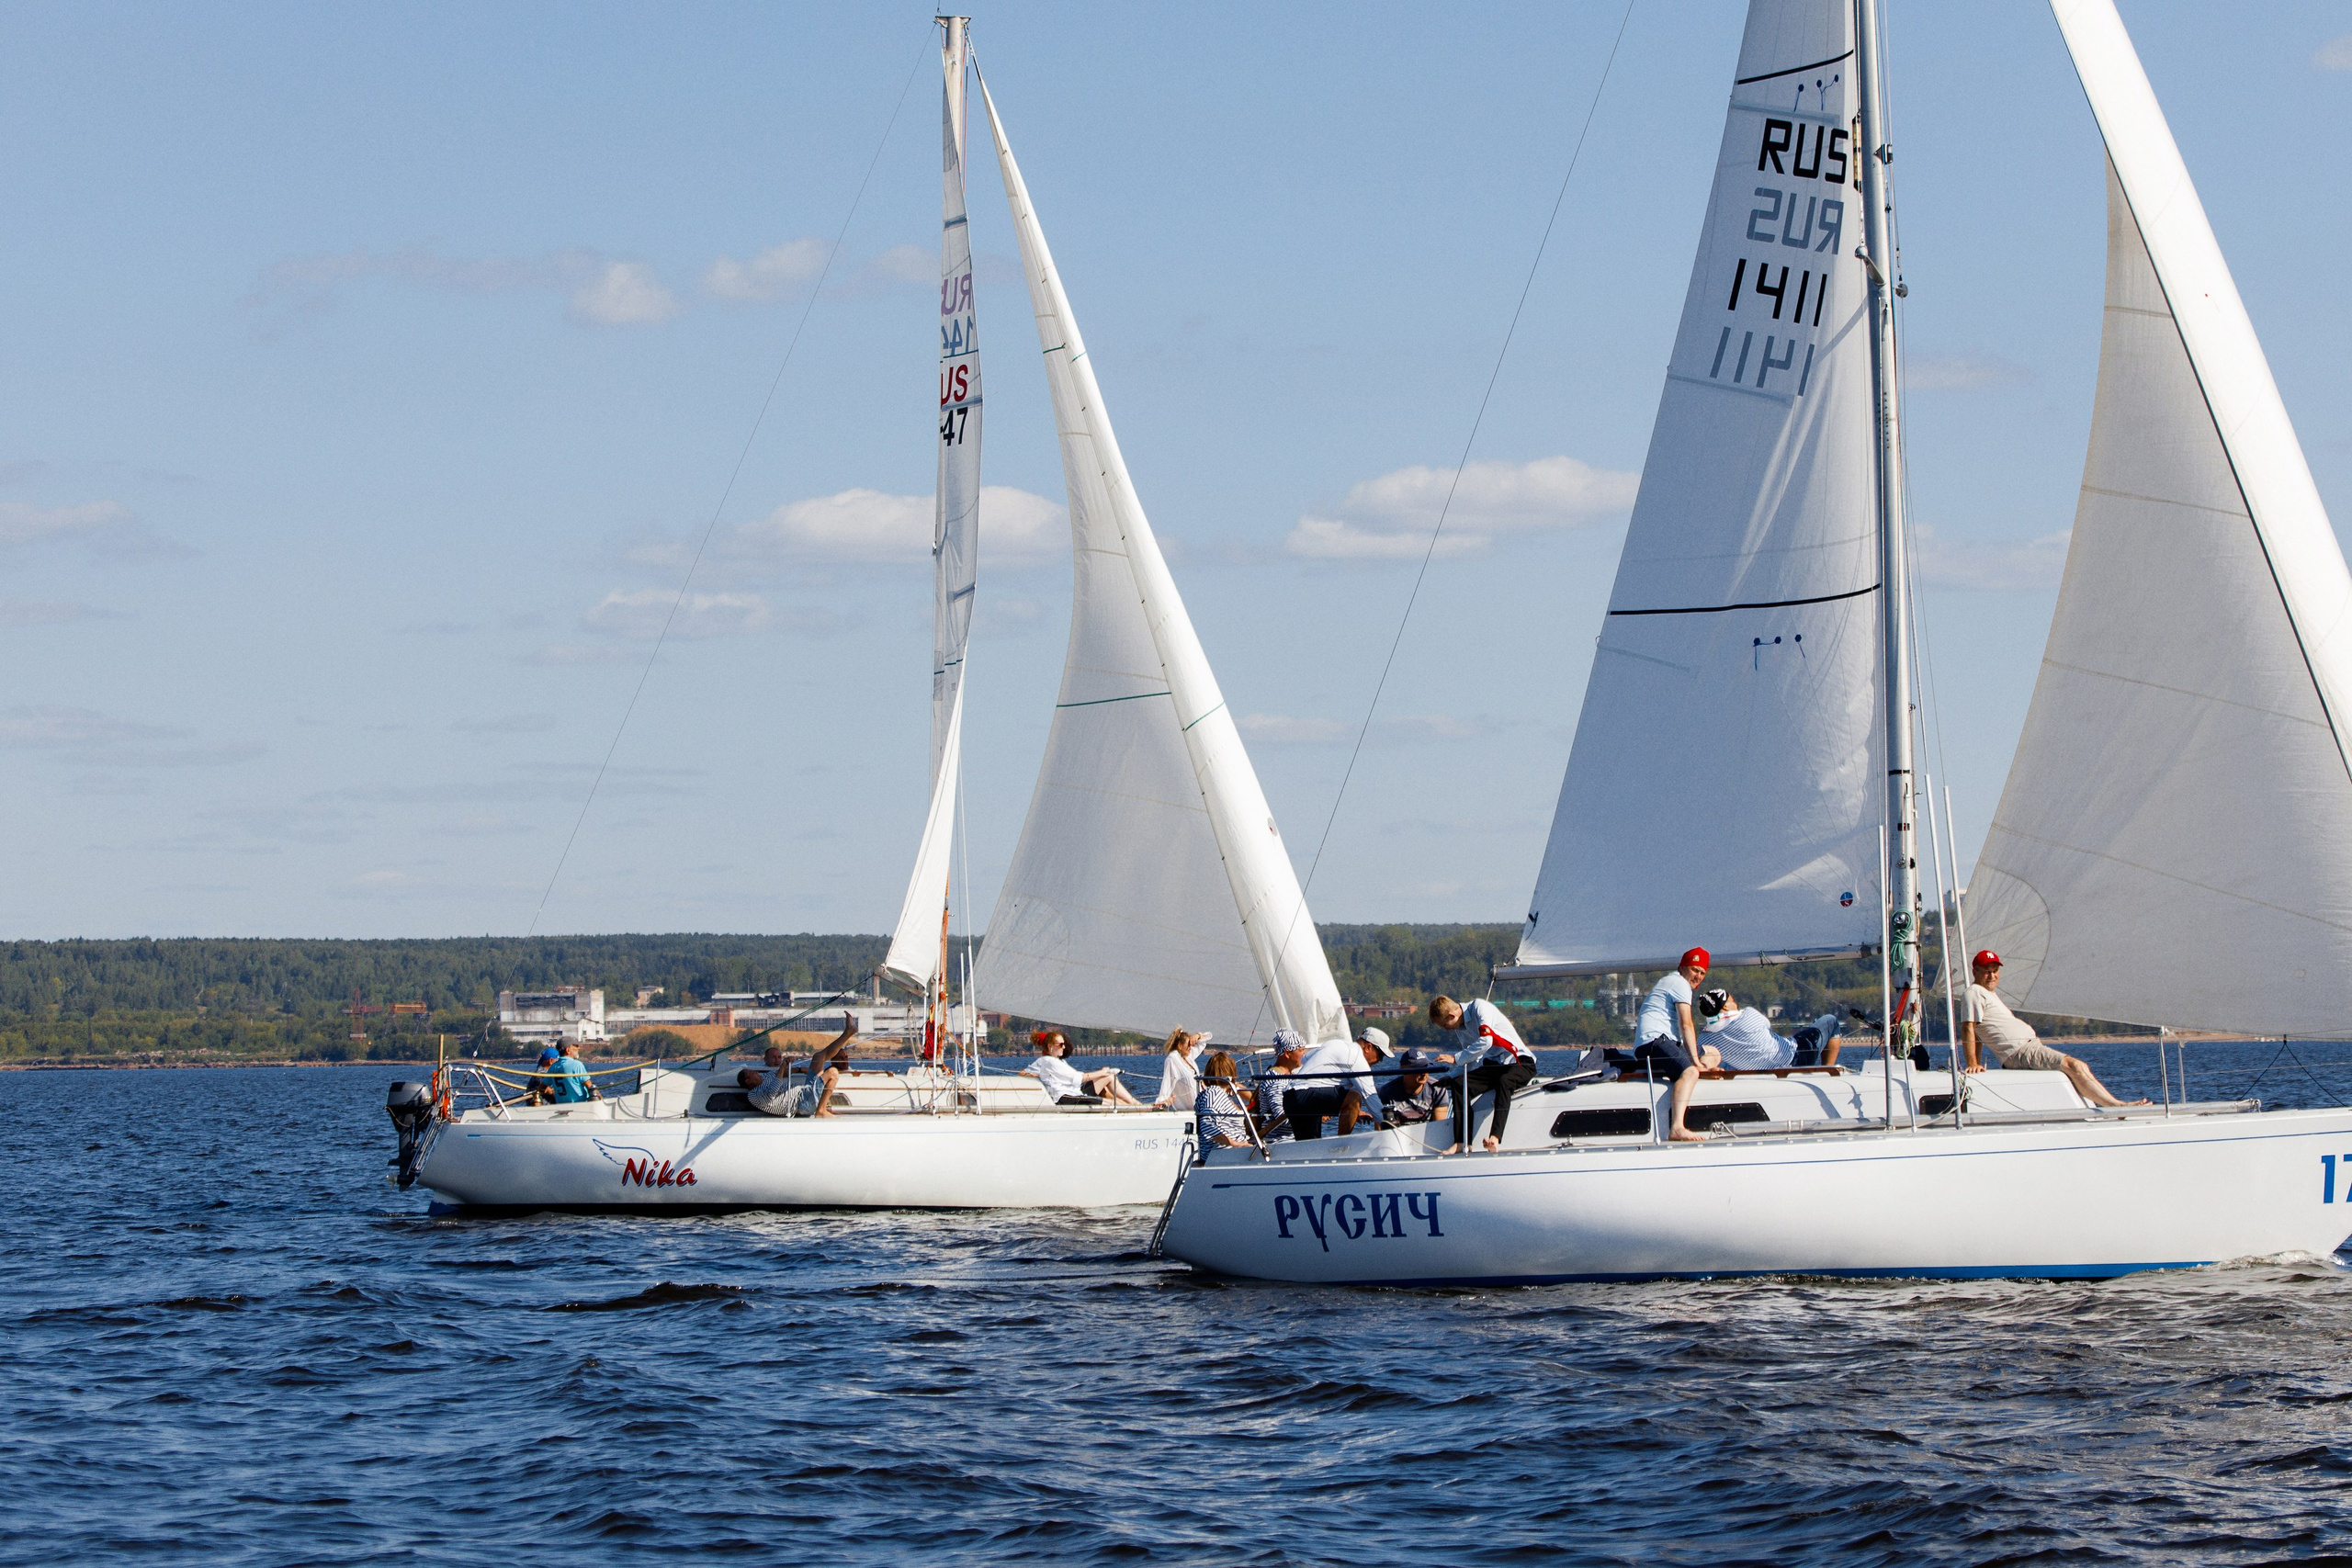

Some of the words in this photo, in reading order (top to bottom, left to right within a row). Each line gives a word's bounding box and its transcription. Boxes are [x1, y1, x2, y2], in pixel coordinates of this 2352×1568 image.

[1758, 118, 1849, 184] RUS
[1727, 258, 1827, 327] 1411
[1135, 1139, 1158, 1150] RUS
[621, 1157, 698, 1188] Nika
